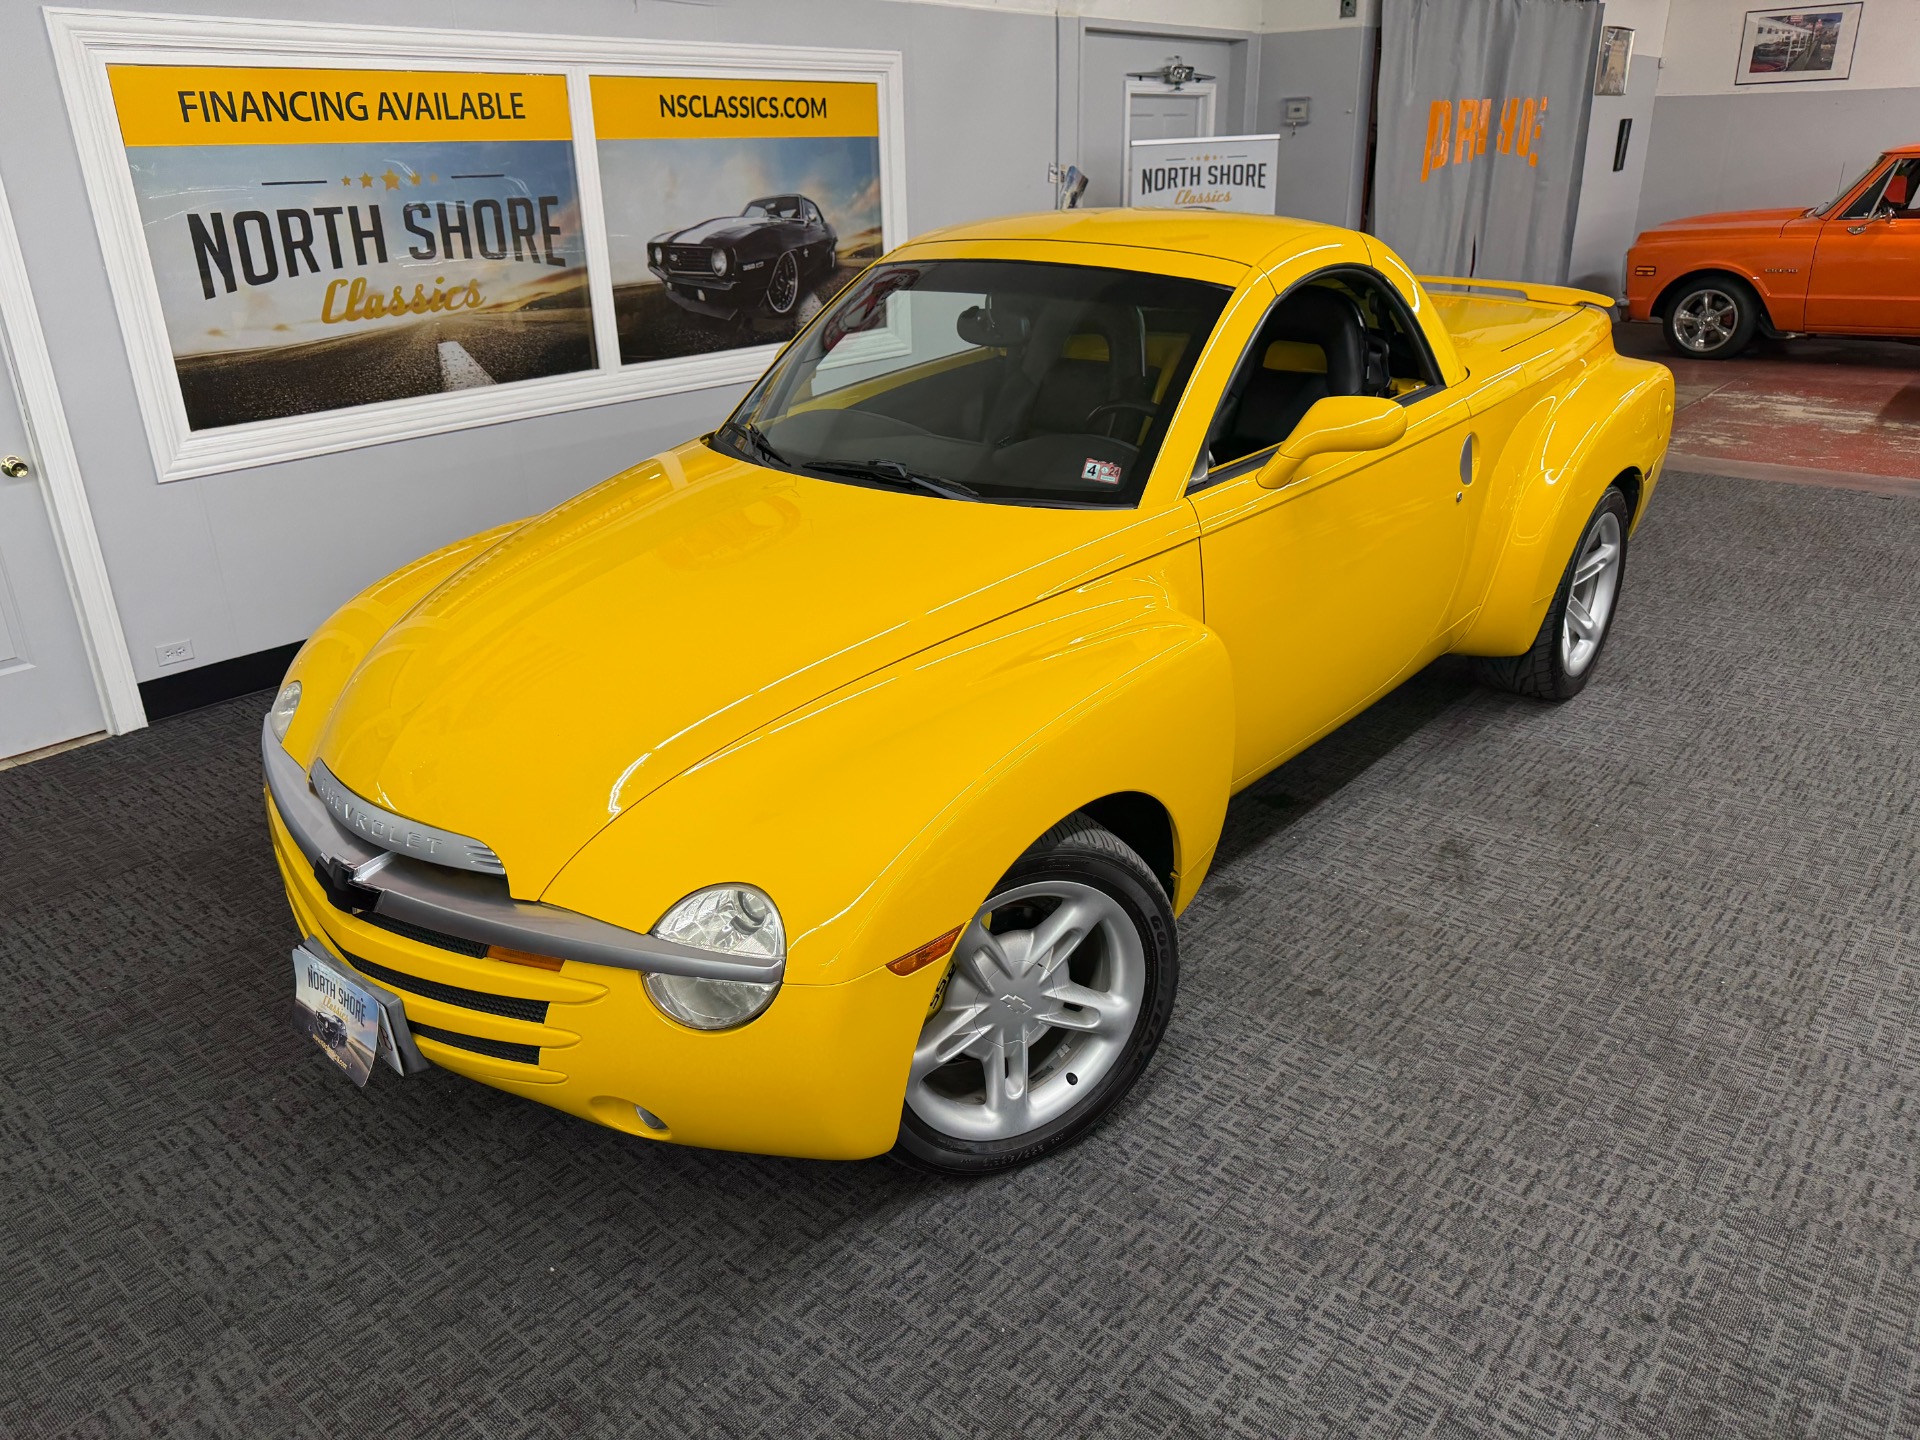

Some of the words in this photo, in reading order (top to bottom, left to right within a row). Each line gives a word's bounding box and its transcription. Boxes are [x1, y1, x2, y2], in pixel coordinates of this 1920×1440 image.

[177, 90, 369, 123] FINANCING
[377, 91, 526, 121] AVAILABLE
[659, 94, 827, 119] NSCLASSICS.COM
[1142, 166, 1201, 195] NORTH
[1207, 163, 1267, 189] SHORE
[1174, 189, 1232, 205] Classics
[187, 203, 389, 300] NORTH
[402, 196, 567, 267] SHORE
[321, 275, 487, 324] Classics
[1087, 464, 1097, 476] 4
[320, 778, 443, 854] CHEVROLET
[307, 965, 336, 999] NORTH
[338, 987, 367, 1028] SHORE
